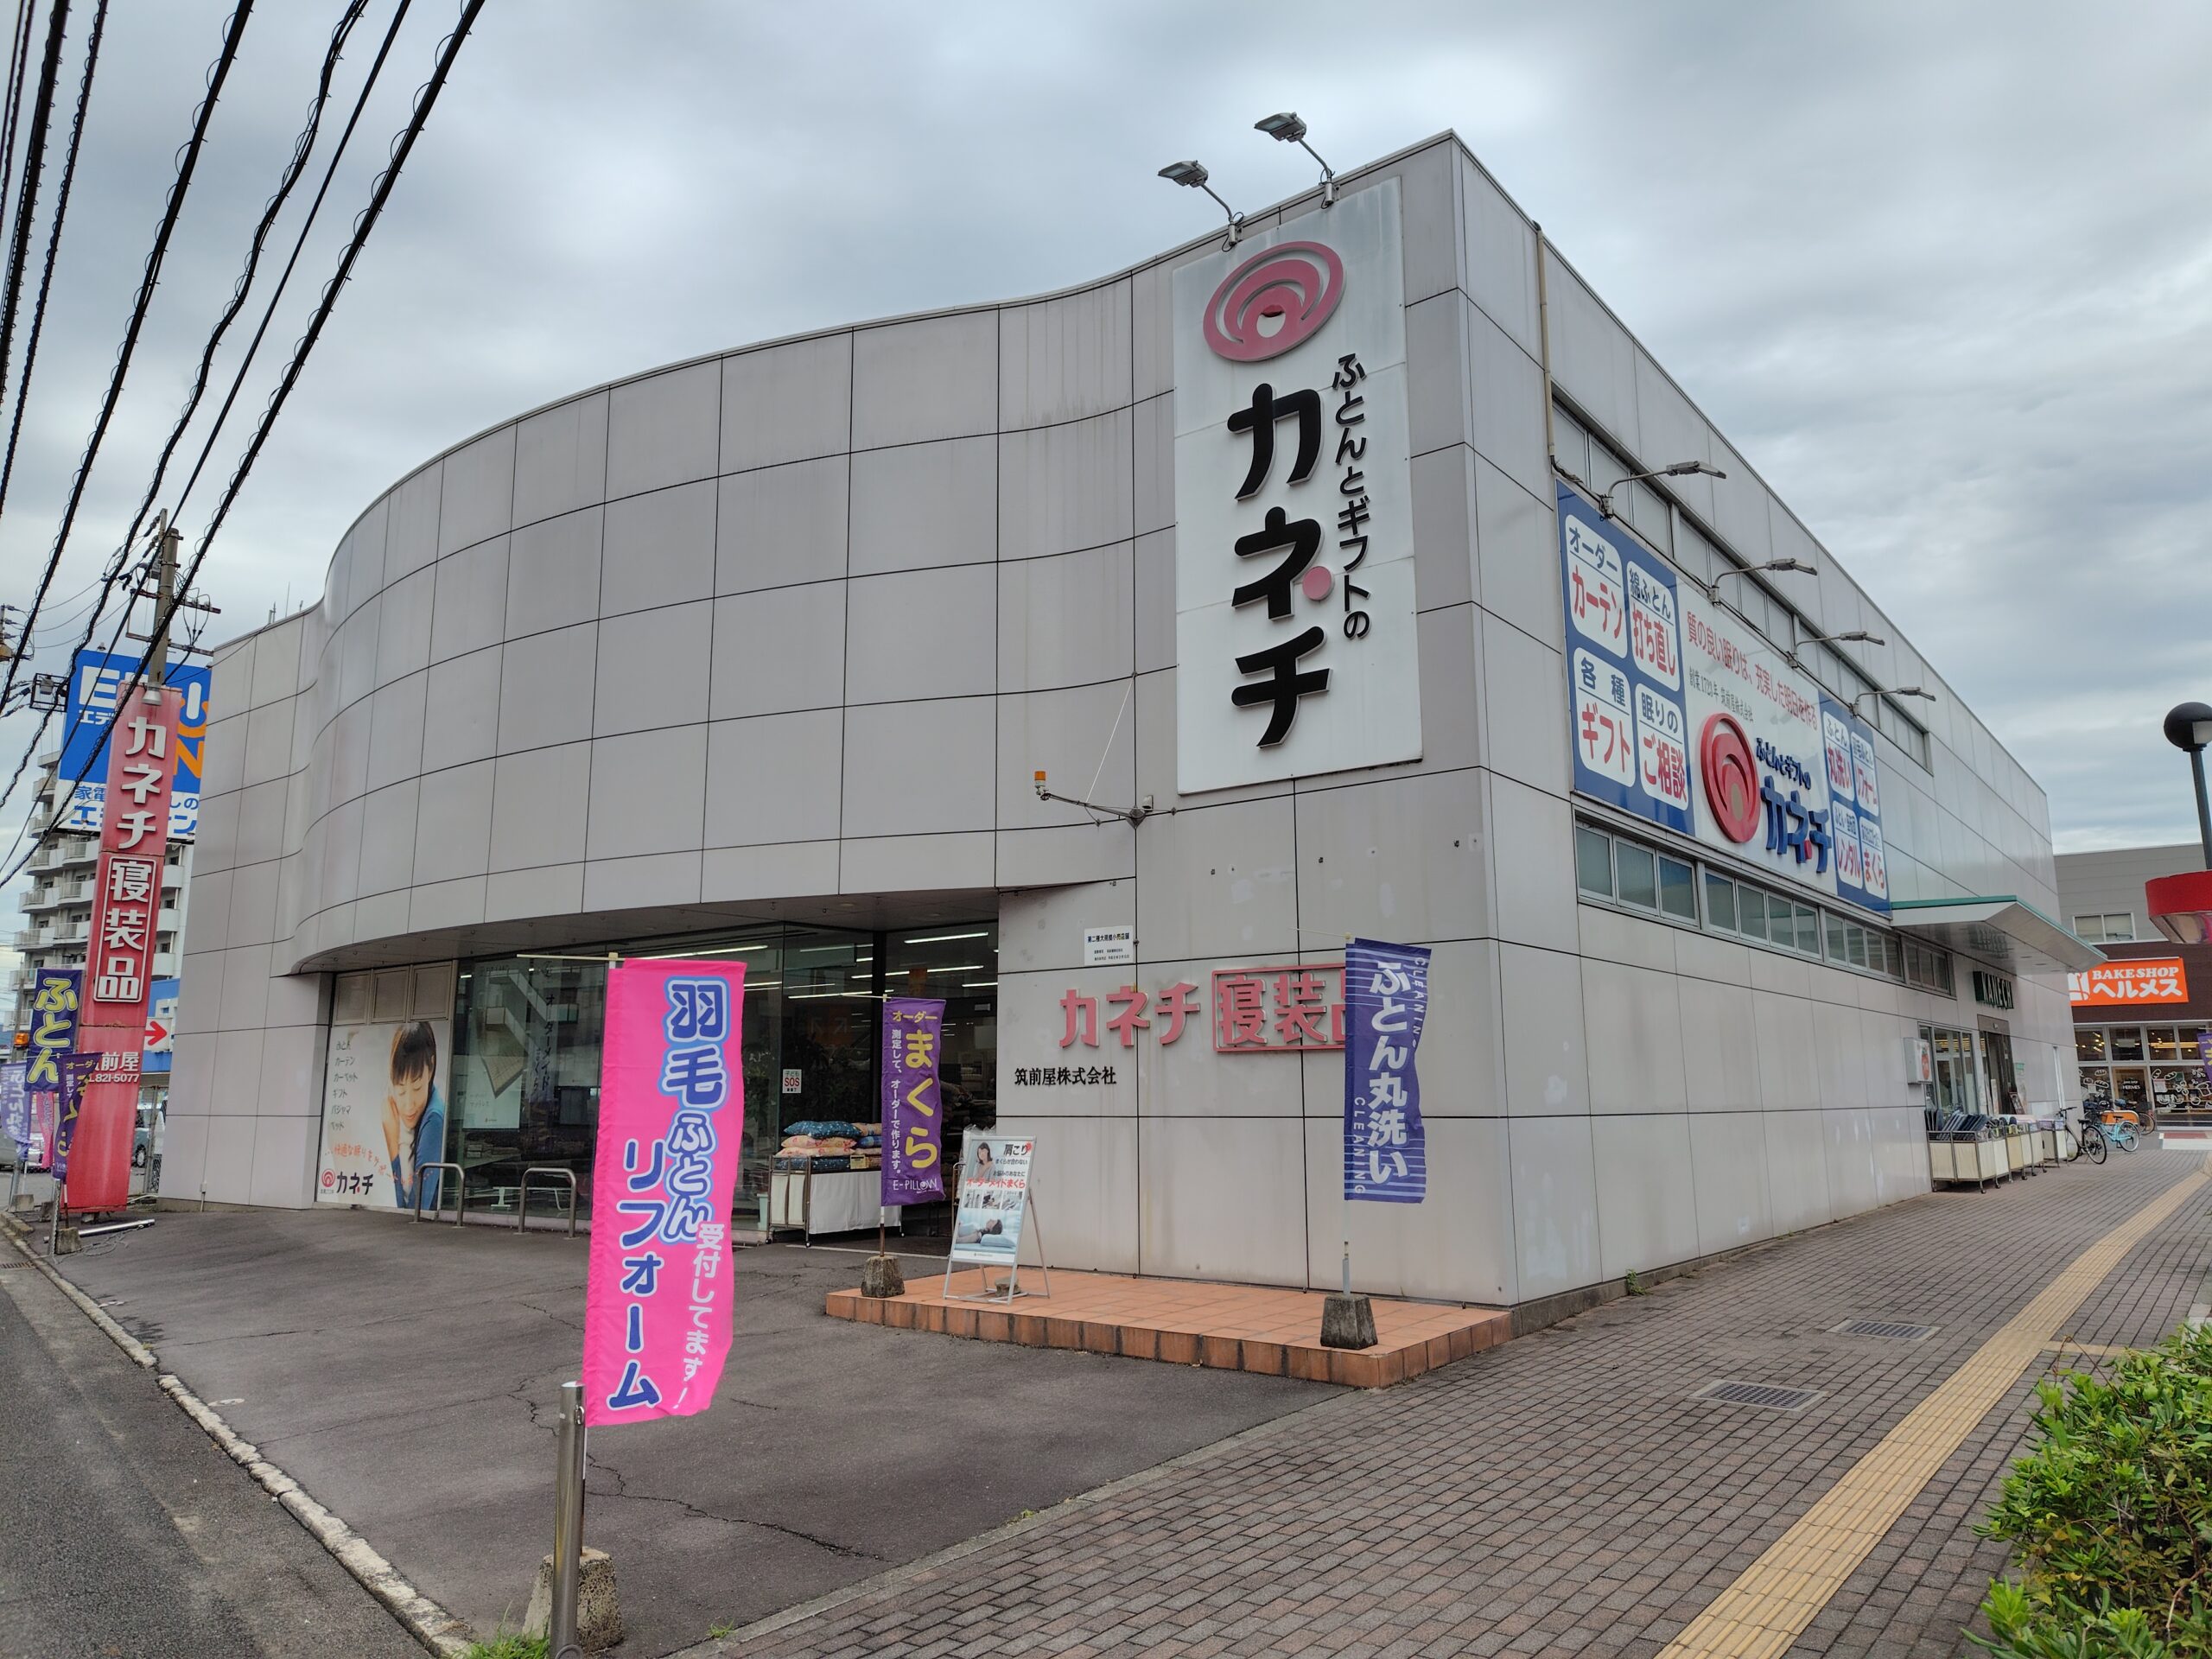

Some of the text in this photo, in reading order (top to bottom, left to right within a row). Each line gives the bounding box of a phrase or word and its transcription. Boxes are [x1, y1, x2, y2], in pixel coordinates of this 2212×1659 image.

[1332, 353, 1371, 640] ふとんとギフトの
[1227, 382, 1333, 748] カネチ
[1569, 526, 1618, 573] オーダー
[1572, 565, 1623, 639] カーテン
[1629, 568, 1672, 620] 綿ふとん
[1632, 602, 1677, 677] 打ち直し
[1582, 702, 1631, 773] ギフト
[1641, 692, 1679, 734] 眠りの
[117, 716, 167, 849] カネチ
[1643, 732, 1688, 803] ご相談
[1760, 775, 1833, 874] カネチ
[97, 861, 152, 1000] 寝装品
[2092, 967, 2179, 980] BAKE SHOP
[2093, 979, 2183, 998] ヘルメス
[27, 977, 79, 1084] ふとん
[893, 1010, 938, 1024] オーダー
[1059, 982, 1201, 1048] カネチ
[95, 1052, 139, 1071] 前屋
[334, 1057, 355, 1066] カーテン
[785, 1077, 800, 1087] SOS
[1014, 1066, 1117, 1086] 筑前屋株式会社
[1368, 960, 1410, 1184] ふとん丸洗い
[659, 978, 728, 1243] 羽毛ふとん
[906, 1029, 938, 1169] まくら
[1004, 1144, 1029, 1156] 肩こり
[1353, 1096, 1366, 1194] CLEANING
[336, 1171, 374, 1195] カネチ
[607, 1138, 668, 1411] リフォーム
